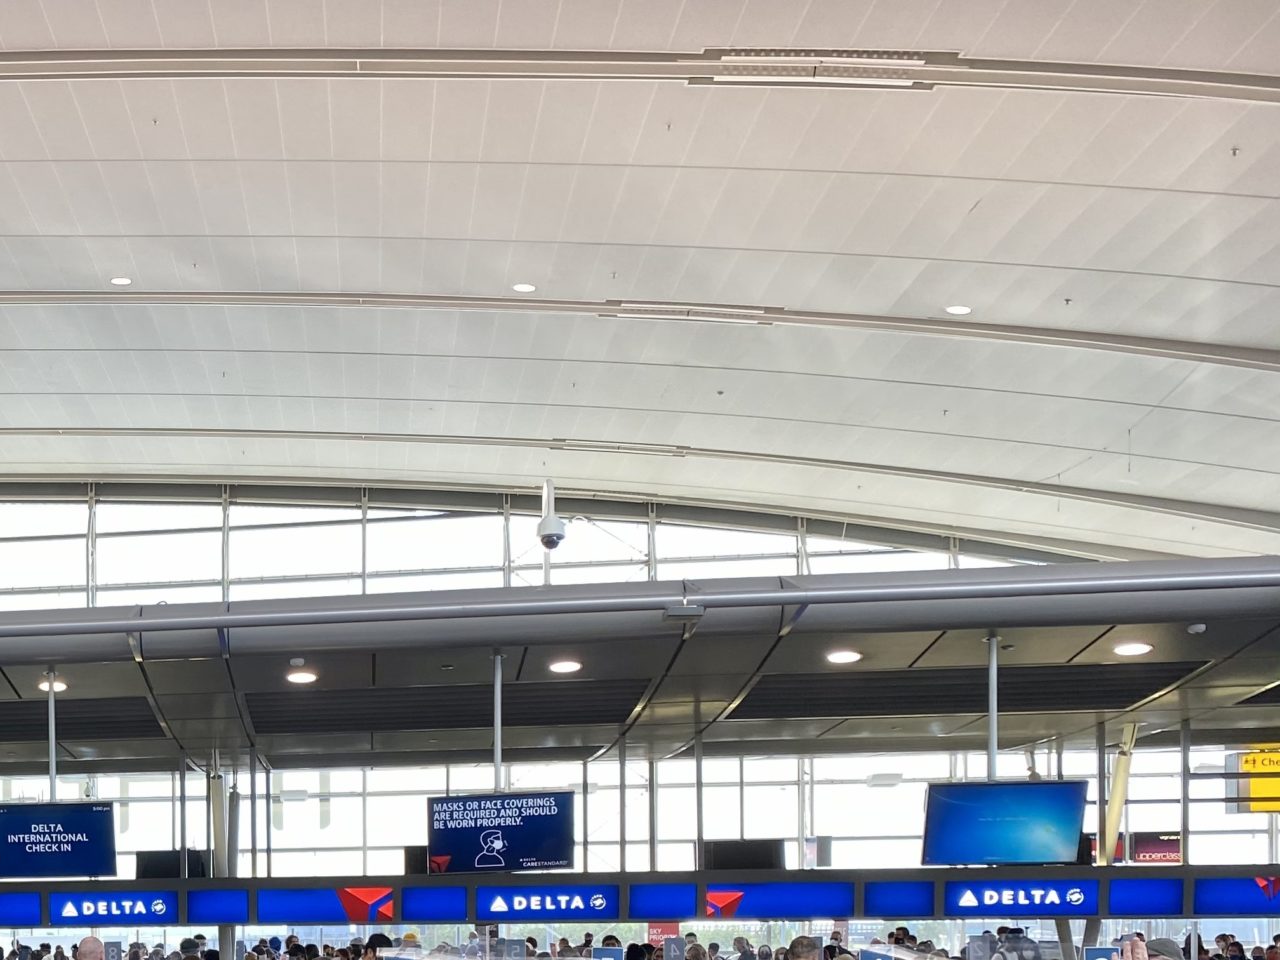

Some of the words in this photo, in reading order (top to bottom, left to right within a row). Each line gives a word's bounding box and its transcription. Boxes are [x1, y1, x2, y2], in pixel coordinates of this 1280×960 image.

[433, 802, 464, 812] MASKS
[466, 801, 479, 810] OR
[481, 799, 502, 809] FACE
[504, 797, 555, 808] COVERINGS
[433, 812, 451, 821] ARE
[454, 809, 497, 820] REQUIRED
[500, 808, 519, 817] AND
[521, 806, 558, 816] SHOULD
[31, 824, 63, 833] DELTA
[433, 820, 445, 829] BE
[447, 819, 475, 829] WORN
[477, 817, 523, 827] PROPERLY.
[7, 833, 88, 843] INTERNATIONAL
[25, 844, 59, 852] CHECK
[61, 843, 72, 852] IN
[514, 895, 585, 911] DELTA
[984, 889, 1061, 905] DELTA
[83, 901, 147, 916] DELTA
